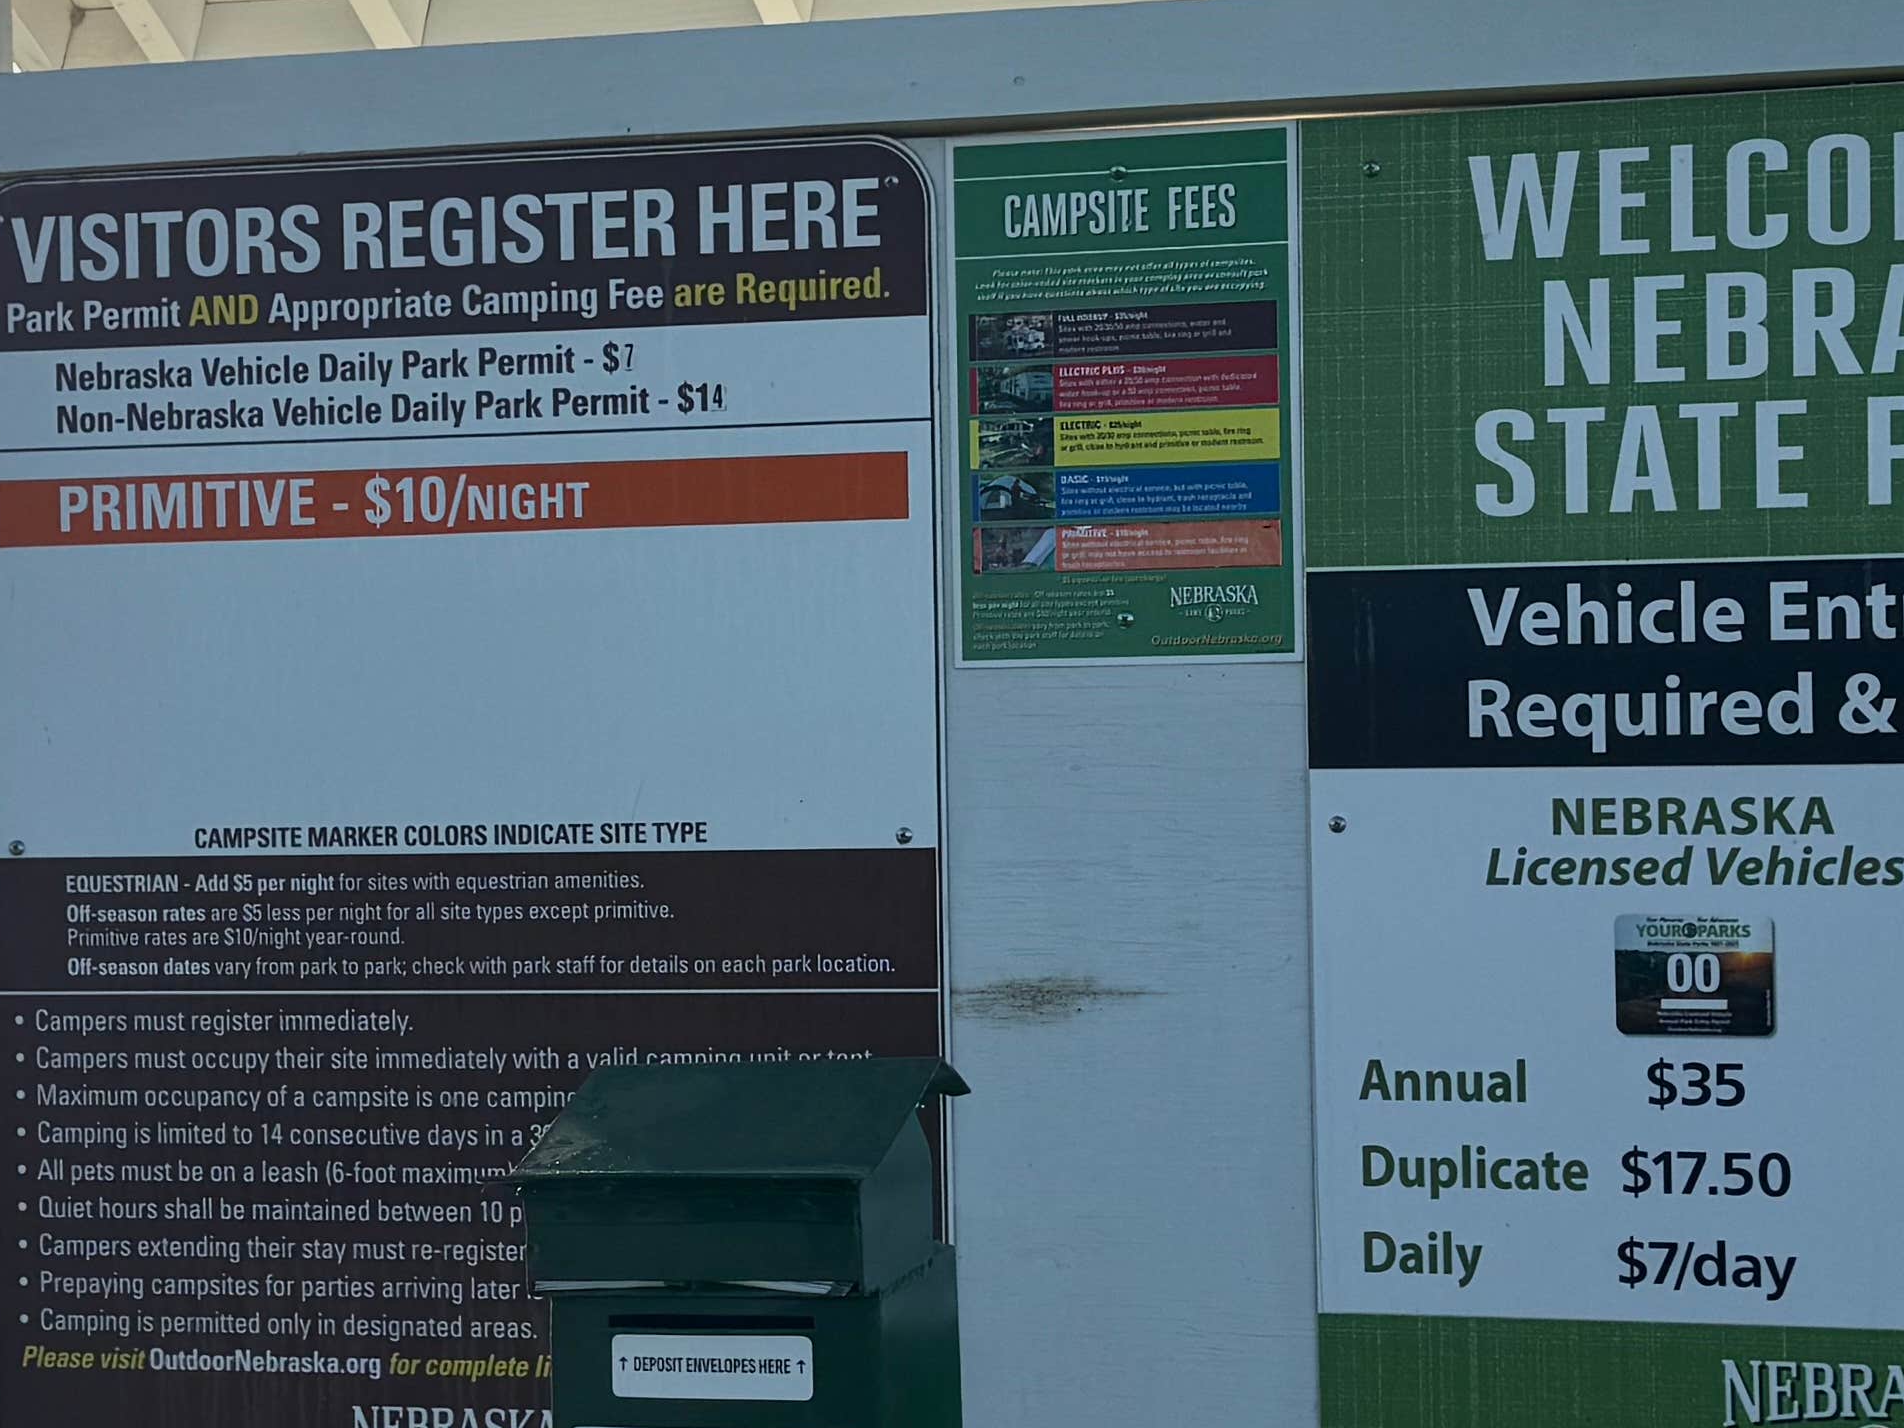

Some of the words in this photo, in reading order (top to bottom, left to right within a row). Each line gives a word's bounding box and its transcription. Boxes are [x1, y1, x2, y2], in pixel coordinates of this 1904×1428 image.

[1005, 189, 1149, 236] CAMPSITE
[1168, 184, 1236, 228] FEES
[11, 206, 320, 281] VISITORS
[343, 190, 675, 267] REGISTER
[699, 179, 880, 252] HERE
[7, 302, 73, 332] Park
[84, 298, 180, 329] Permit
[189, 294, 257, 325] AND
[268, 289, 451, 330] Appropriate
[462, 282, 597, 320] Camping
[609, 279, 663, 309] Fee
[675, 283, 724, 306] are
[736, 268, 889, 309] Required.
[56, 360, 191, 391] Nebraska
[201, 356, 308, 385] Vehicle
[319, 352, 392, 386] Daily
[402, 349, 468, 378] Park
[479, 345, 574, 375] Permit
[603, 341, 633, 373] $7
[57, 401, 263, 432] Non-Nebraska
[272, 396, 381, 426] Vehicle
[392, 392, 466, 427] Daily
[476, 389, 542, 419] Park
[552, 386, 649, 416] Permit
[677, 382, 726, 413] $14
[1472, 401, 1807, 514] STATE
[60, 479, 314, 530] PRIMITIVE
[365, 476, 591, 533] $10/NIGHT
[1170, 585, 1258, 607] NEBRASKA
[1467, 582, 1744, 644] Vehicle
[1151, 633, 1283, 647] OutdoorNebraska.org
[1468, 673, 1813, 750] Required
[1839, 673, 1896, 733] &
[195, 827, 302, 848] CAMPSITE
[306, 826, 397, 846] MARKER
[403, 825, 488, 846] COLORS
[492, 824, 593, 844] INDICATE
[599, 822, 647, 844] SITE
[650, 821, 706, 843] TYPE
[1552, 797, 1834, 835] NEBRASKA
[66, 874, 178, 892] EQUESTRIAN
[195, 874, 228, 891] Add
[233, 874, 252, 892] $5
[257, 878, 285, 896] per
[291, 873, 333, 895] night
[339, 873, 362, 890] for
[368, 873, 407, 890] sites
[413, 872, 449, 889] with
[456, 872, 547, 892] equestrian
[555, 870, 643, 888] amenities.
[1486, 846, 1693, 885] Licensed
[1706, 846, 1904, 885] Vehicles
[68, 928, 138, 945] Primitive
[145, 931, 186, 945] rates
[192, 932, 218, 945] are
[224, 927, 300, 948] $10/night
[305, 927, 404, 948] year-round.
[1636, 924, 1683, 938] YOUR
[1697, 924, 1751, 938] PARKS
[1666, 952, 1721, 994] 00
[36, 1009, 126, 1035] Campers
[134, 1013, 185, 1030] must
[191, 1010, 272, 1035] register
[279, 1009, 412, 1035] immediately.
[1359, 1059, 1526, 1102] Annual
[1647, 1059, 1745, 1108] $35
[1362, 1145, 1588, 1198] Duplicate
[1622, 1148, 1790, 1196] $17.50
[39, 1196, 93, 1218] Quiet
[99, 1197, 157, 1218] hours
[164, 1197, 212, 1219] shall
[220, 1198, 244, 1219] be
[252, 1199, 369, 1220] maintained
[378, 1200, 471, 1221] between
[481, 1201, 502, 1222] 10
[40, 1233, 131, 1259] Campers
[138, 1236, 239, 1262] extending
[247, 1236, 295, 1258] their
[302, 1240, 345, 1263] stay
[353, 1241, 405, 1259] must
[412, 1239, 526, 1265] re-register
[1363, 1231, 1482, 1286] Daily
[1617, 1239, 1796, 1299] $7/day
[41, 1308, 129, 1336] Camping
[137, 1310, 153, 1331] is
[161, 1312, 259, 1336] permitted
[267, 1313, 310, 1339] only
[318, 1312, 334, 1335] in
[343, 1314, 461, 1341] designated
[470, 1322, 536, 1338] areas.
[22, 1346, 93, 1367] Please
[101, 1347, 145, 1369] visit
[150, 1348, 380, 1378] OutdoorNebraska.org
[390, 1352, 420, 1374] for
[426, 1355, 528, 1381] complete
[633, 1356, 684, 1373] DEPOSIT
[686, 1357, 756, 1374] ENVELOPES
[759, 1359, 791, 1375] HERE
